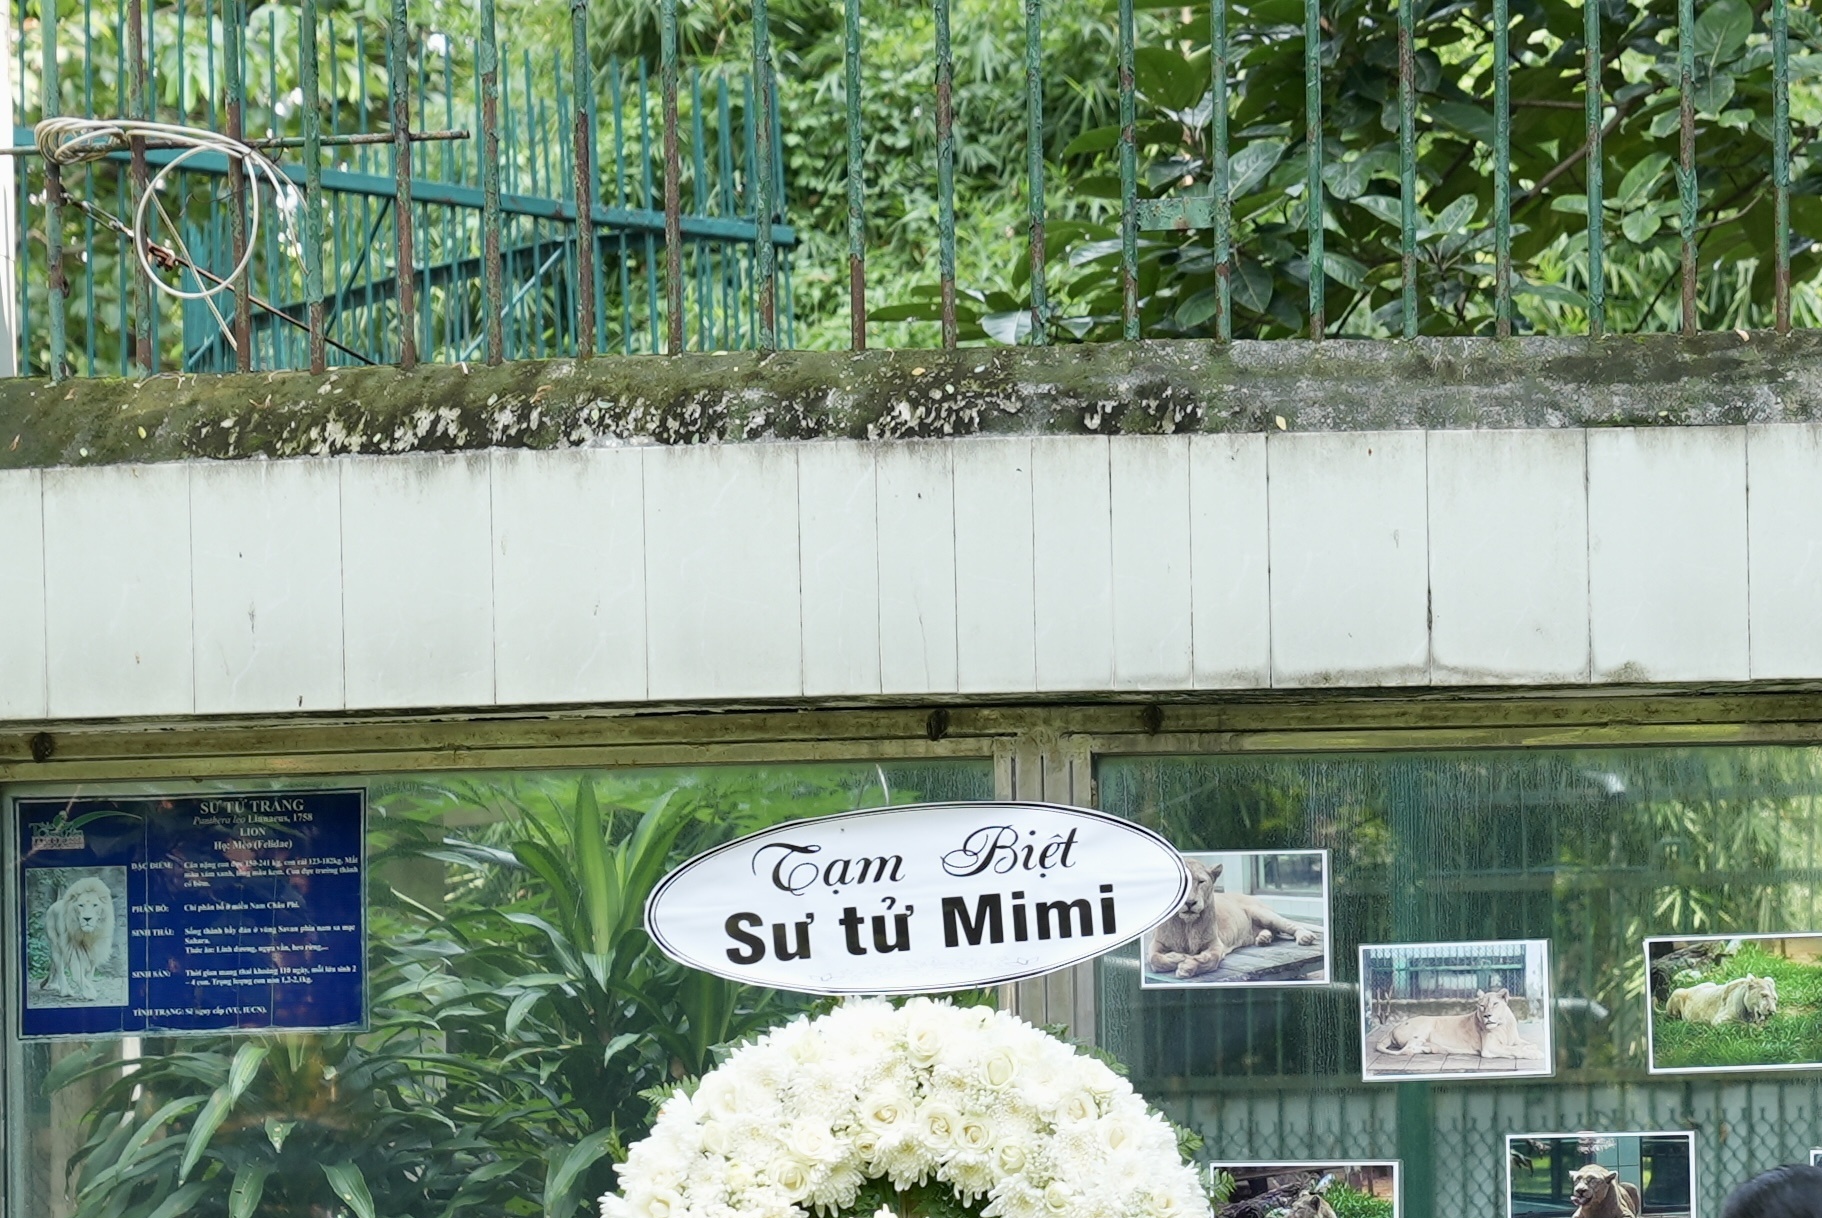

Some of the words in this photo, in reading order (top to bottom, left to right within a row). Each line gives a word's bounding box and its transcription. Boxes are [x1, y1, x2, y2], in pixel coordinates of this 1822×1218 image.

[252, 798, 304, 812] TRẮNG
[293, 813, 313, 822] 1758
[240, 828, 266, 837] LION
[254, 840, 293, 849] (Felidae)
[752, 842, 904, 897] Tạm
[940, 825, 1078, 878] Biệt
[724, 911, 815, 965] Sư
[838, 896, 914, 955] tử
[941, 884, 1117, 947] Mimi
